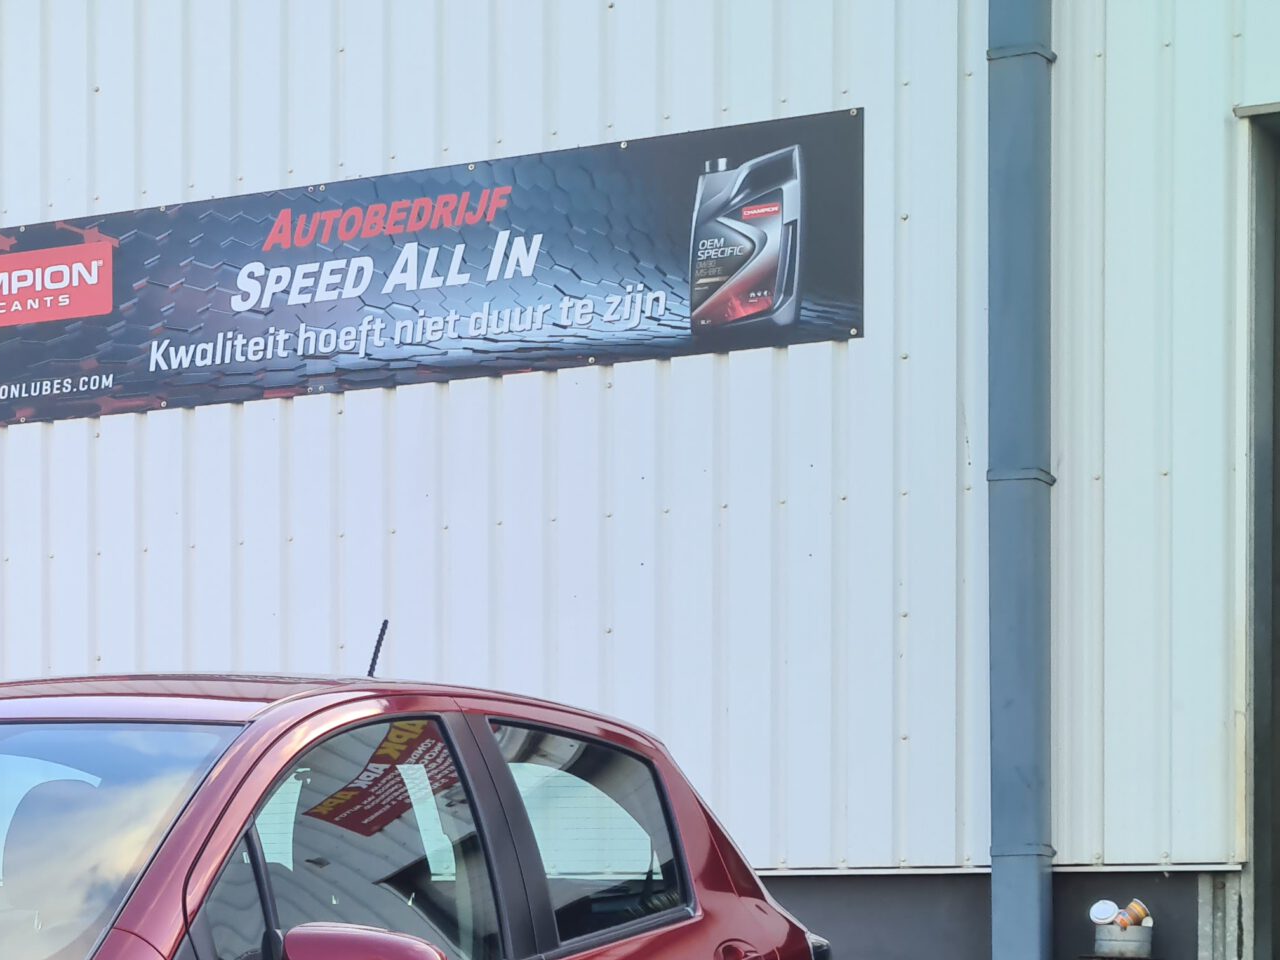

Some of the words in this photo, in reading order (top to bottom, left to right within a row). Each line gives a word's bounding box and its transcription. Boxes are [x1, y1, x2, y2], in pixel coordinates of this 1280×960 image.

[262, 186, 512, 252] AUTOBEDRIJF
[699, 238, 724, 250] OEM
[231, 256, 374, 312] SPEED
[381, 242, 470, 294] ALL
[486, 229, 543, 282] IN
[697, 246, 744, 261] SPECIFIC
[148, 327, 288, 373] Kwaliteit
[297, 315, 386, 358] hoeft
[394, 308, 461, 345] niet
[468, 301, 551, 337] duur
[559, 295, 594, 327] te
[604, 284, 667, 327] zijn
